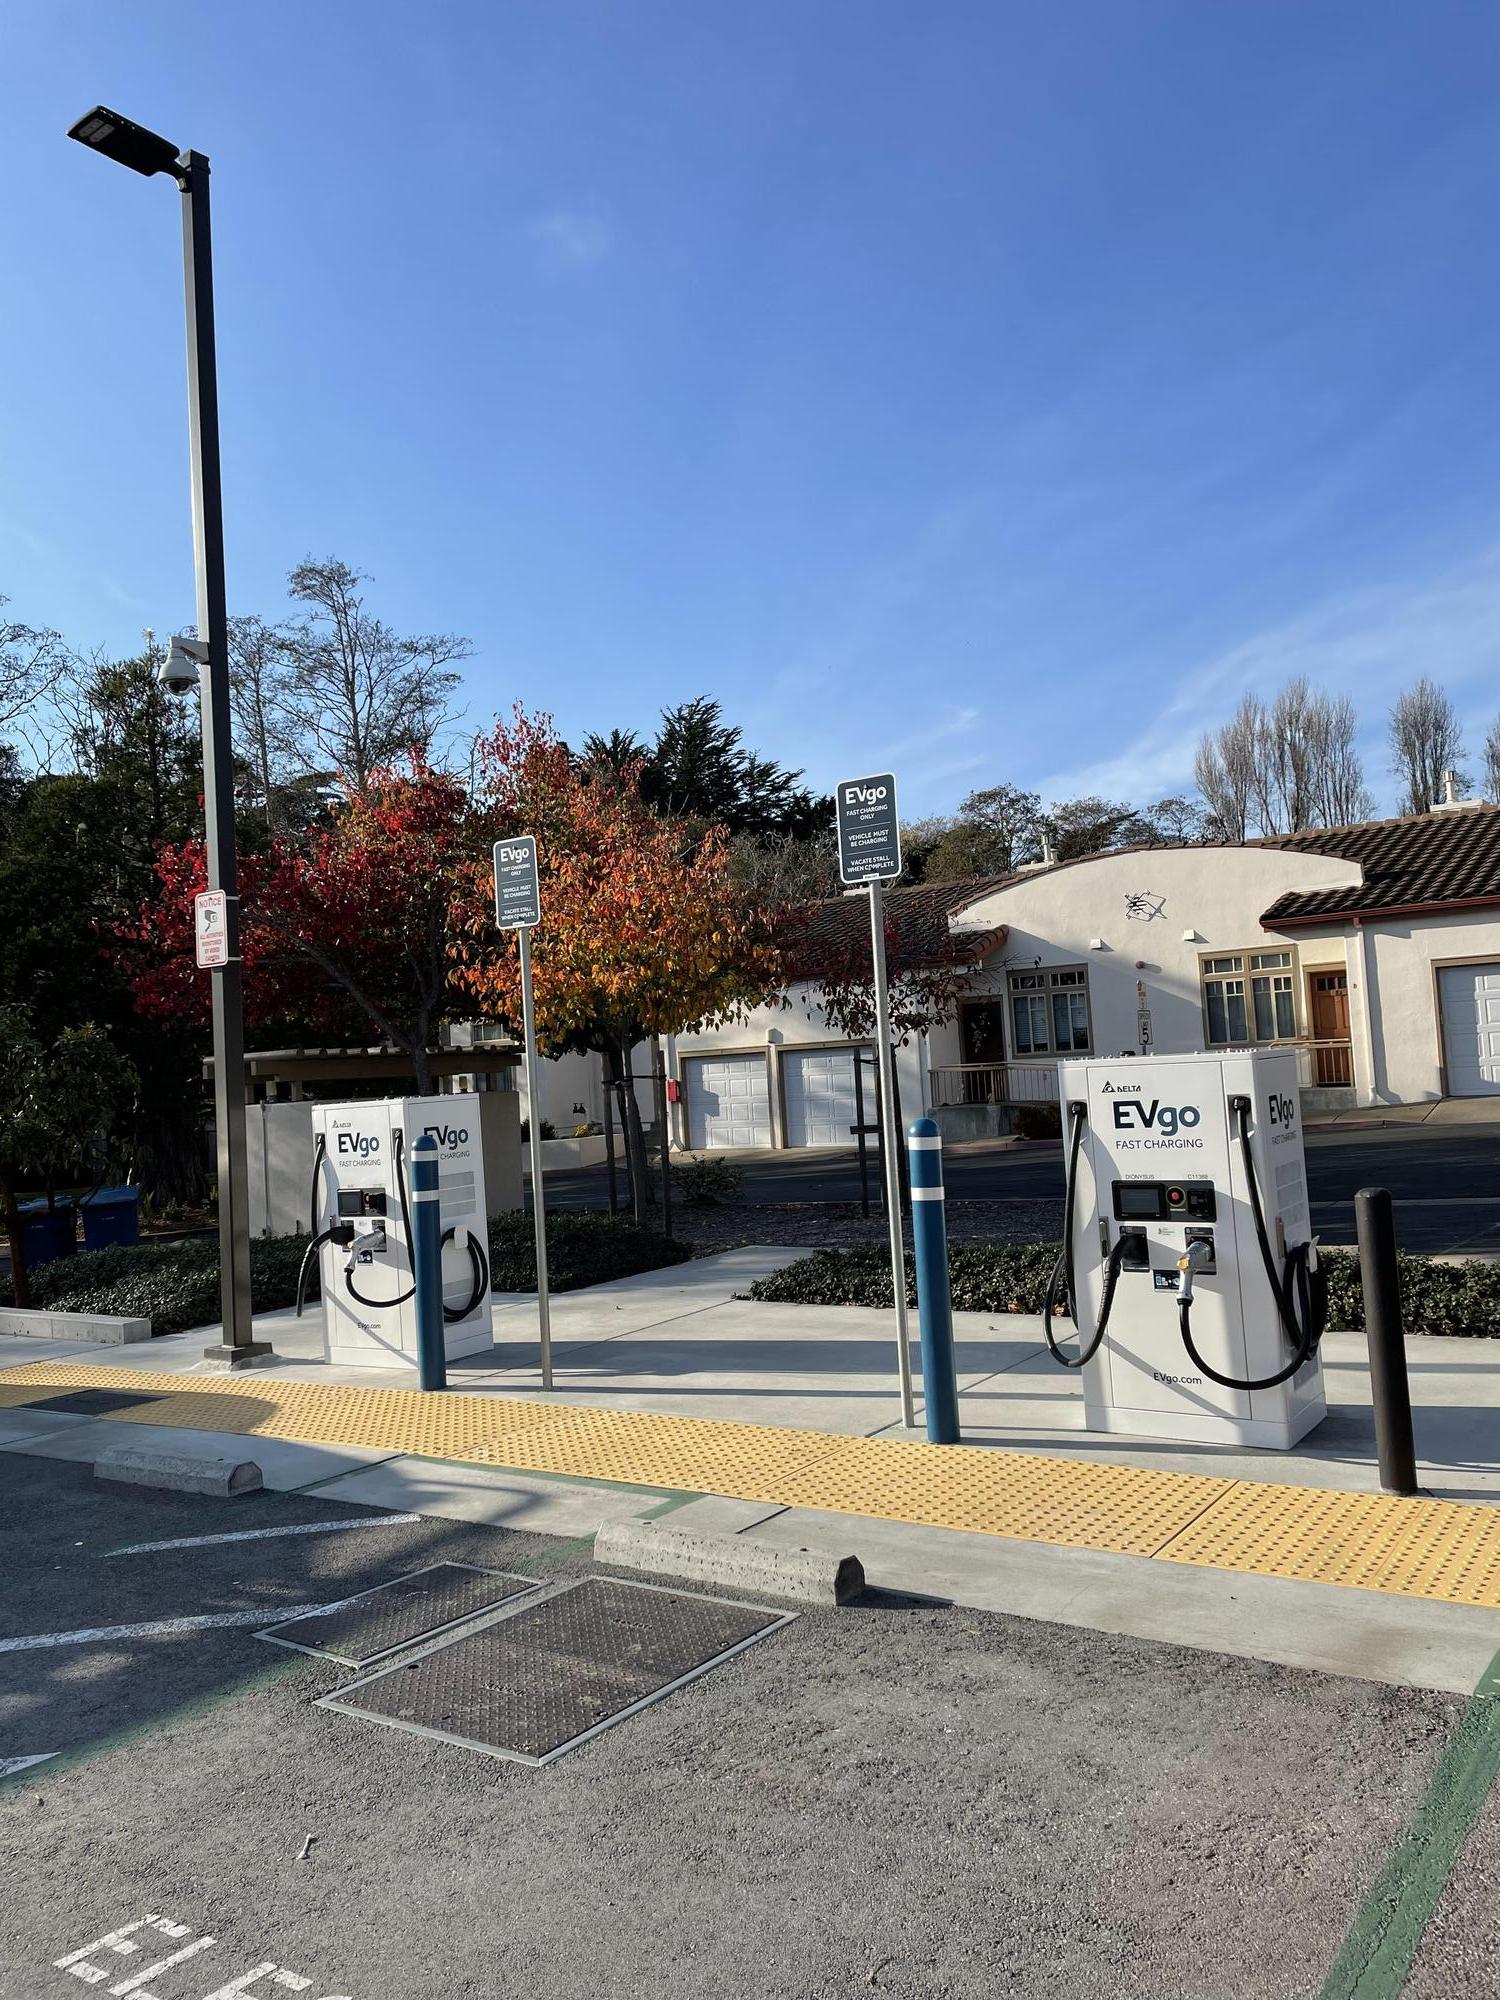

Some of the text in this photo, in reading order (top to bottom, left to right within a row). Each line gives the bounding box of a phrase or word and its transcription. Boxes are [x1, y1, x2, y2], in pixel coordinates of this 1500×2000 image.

[846, 784, 887, 805] EVgo
[860, 804, 888, 814] CHARGING
[848, 832, 872, 841] VEHICLE
[858, 836, 888, 846] CHARGING
[501, 846, 530, 863] EVgo
[851, 858, 872, 866] VACATE
[865, 861, 894, 871] COMPLETE
[199, 897, 222, 908] NOTICE
[1142, 1028, 1149, 1043] 5
[1269, 1093, 1294, 1129] EVgo
[1113, 1100, 1200, 1136] EVgo
[338, 1132, 379, 1158] EVgo
[1116, 1139, 1203, 1149] FAST CHARGING
[440, 1151, 470, 1160] CHARGING
[353, 1159, 382, 1167] CHARGING
[358, 1322, 381, 1330] EVgo.com
[1153, 1372, 1202, 1384] EVgo.com
